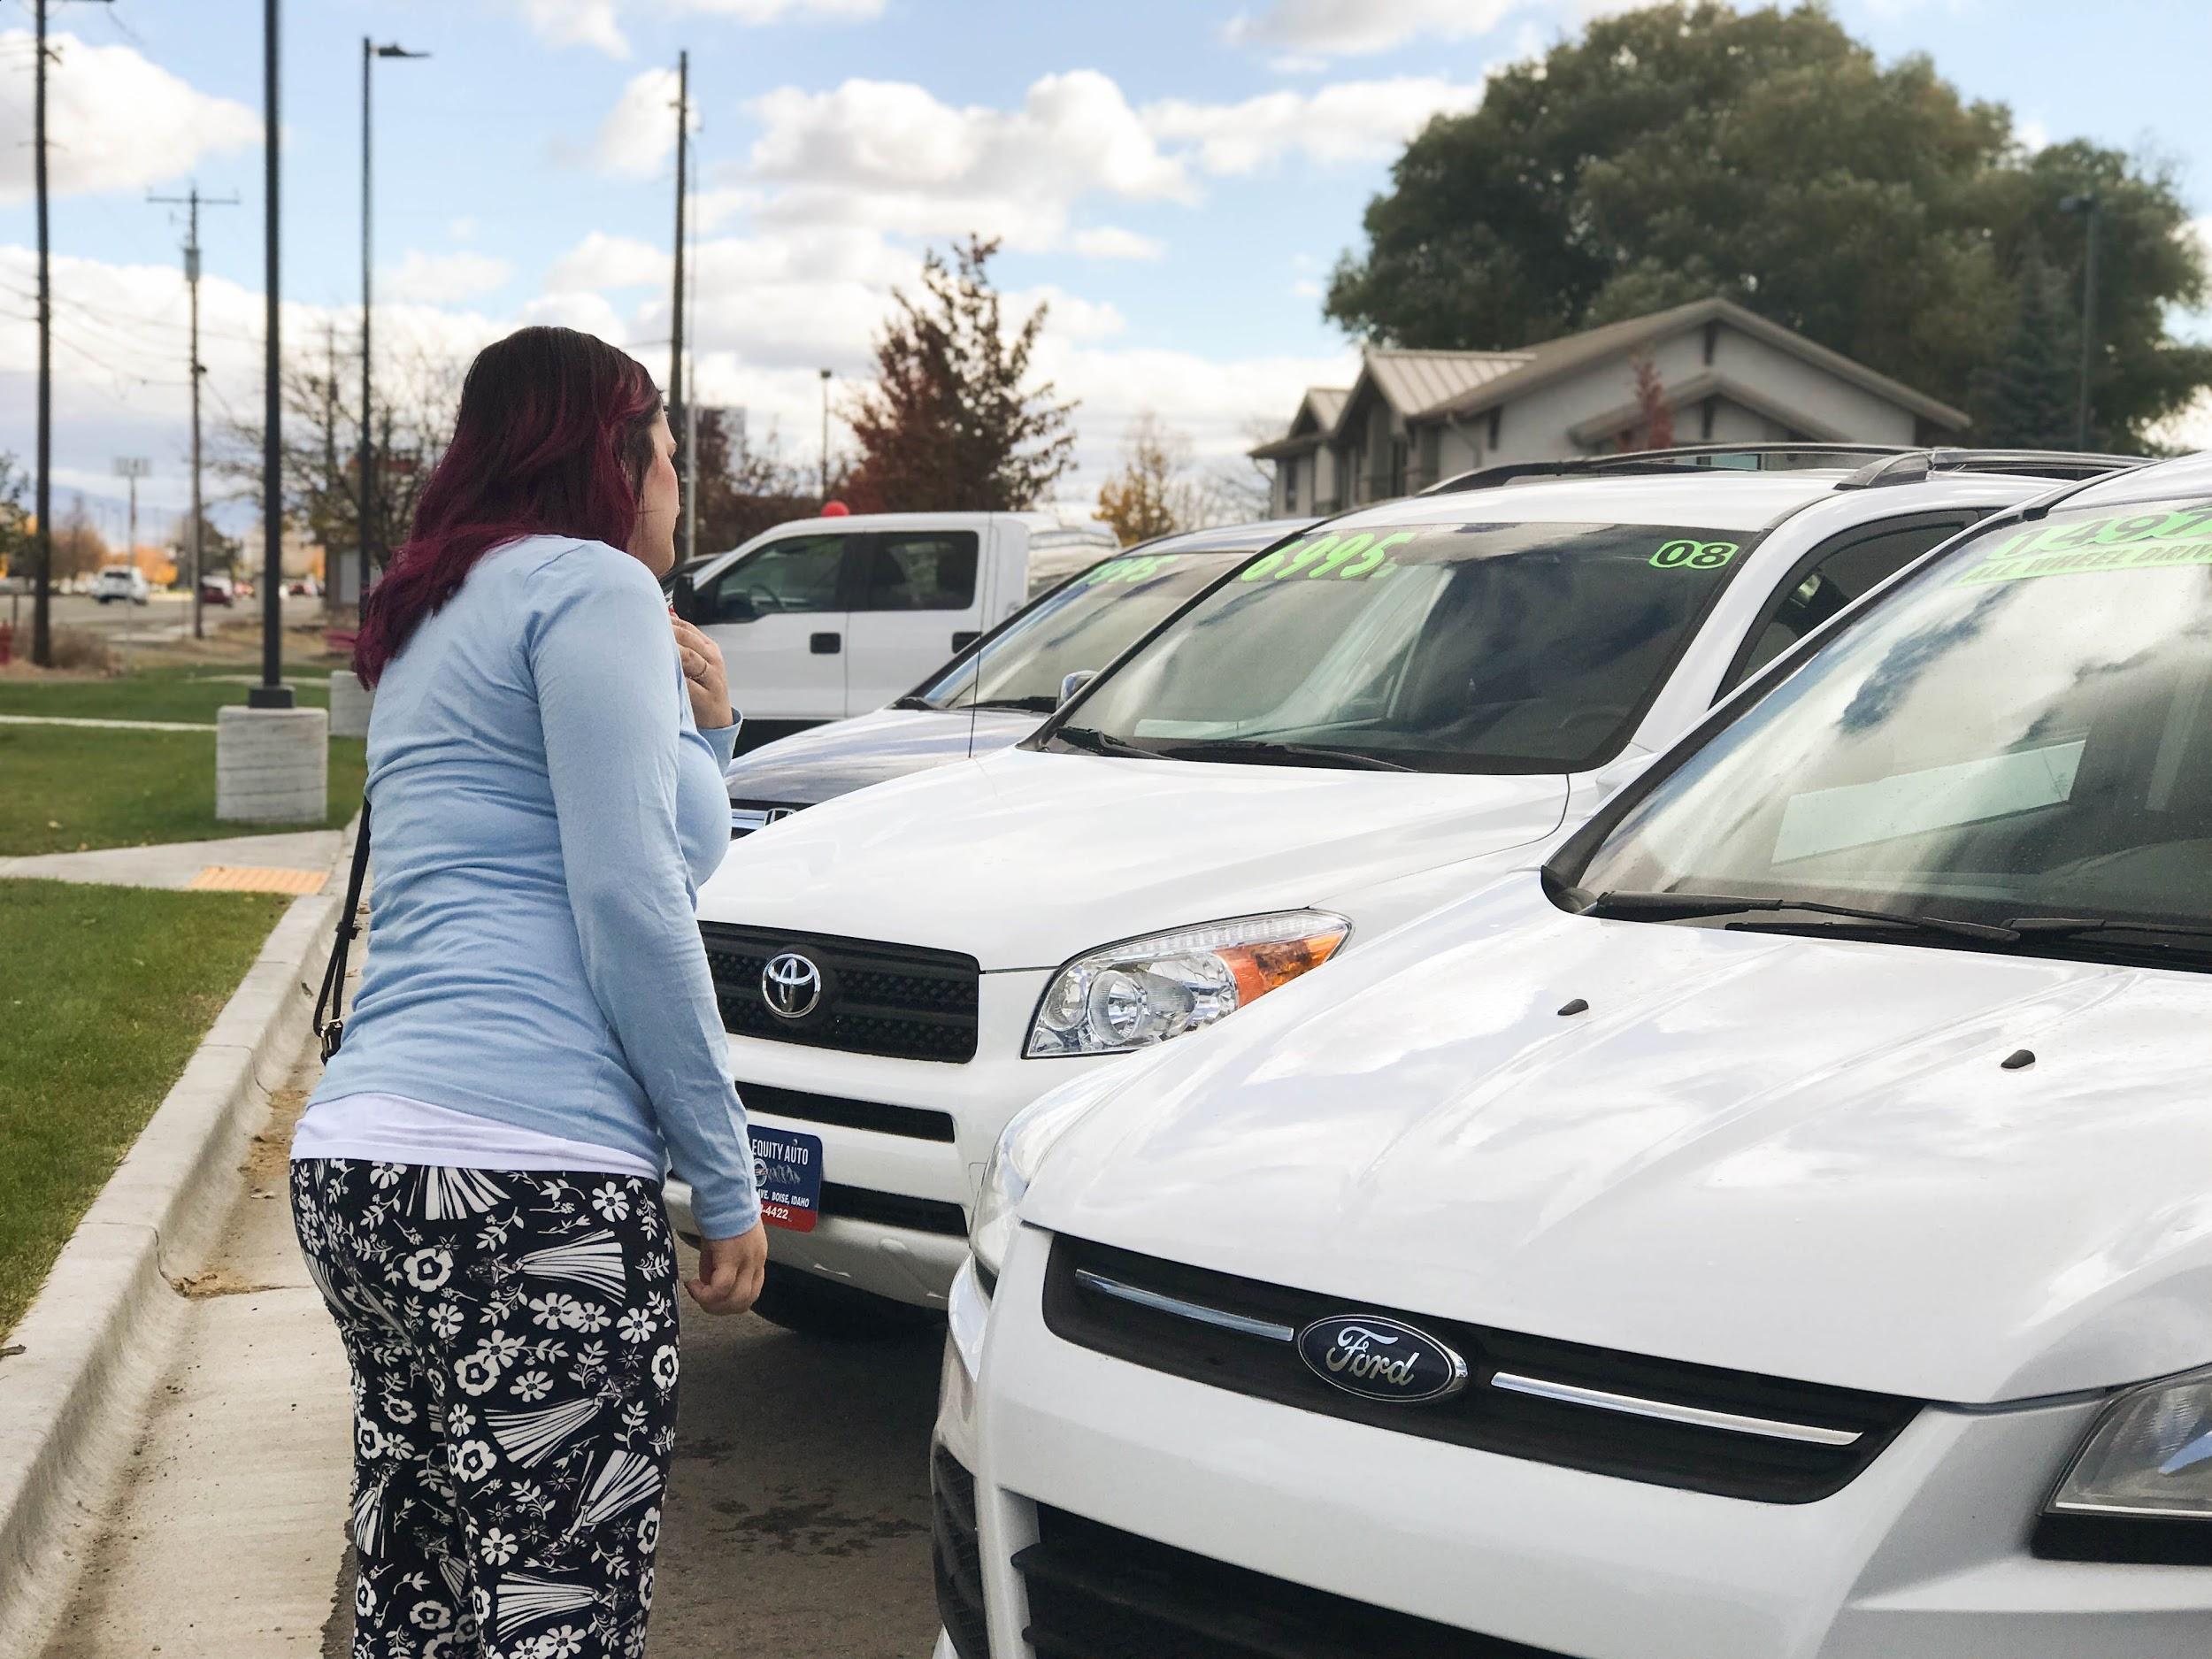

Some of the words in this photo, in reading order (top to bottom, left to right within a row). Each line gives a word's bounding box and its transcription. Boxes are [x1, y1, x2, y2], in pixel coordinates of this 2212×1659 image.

[1240, 533, 1416, 581] 6995
[1651, 540, 1737, 568] 08
[752, 1139, 783, 1160] EQUITY
[784, 1145, 809, 1165] AUTO
[772, 1192, 790, 1206] BOISE,
[791, 1195, 810, 1208] IDAHO
[1326, 1326, 1420, 1386] Ford
